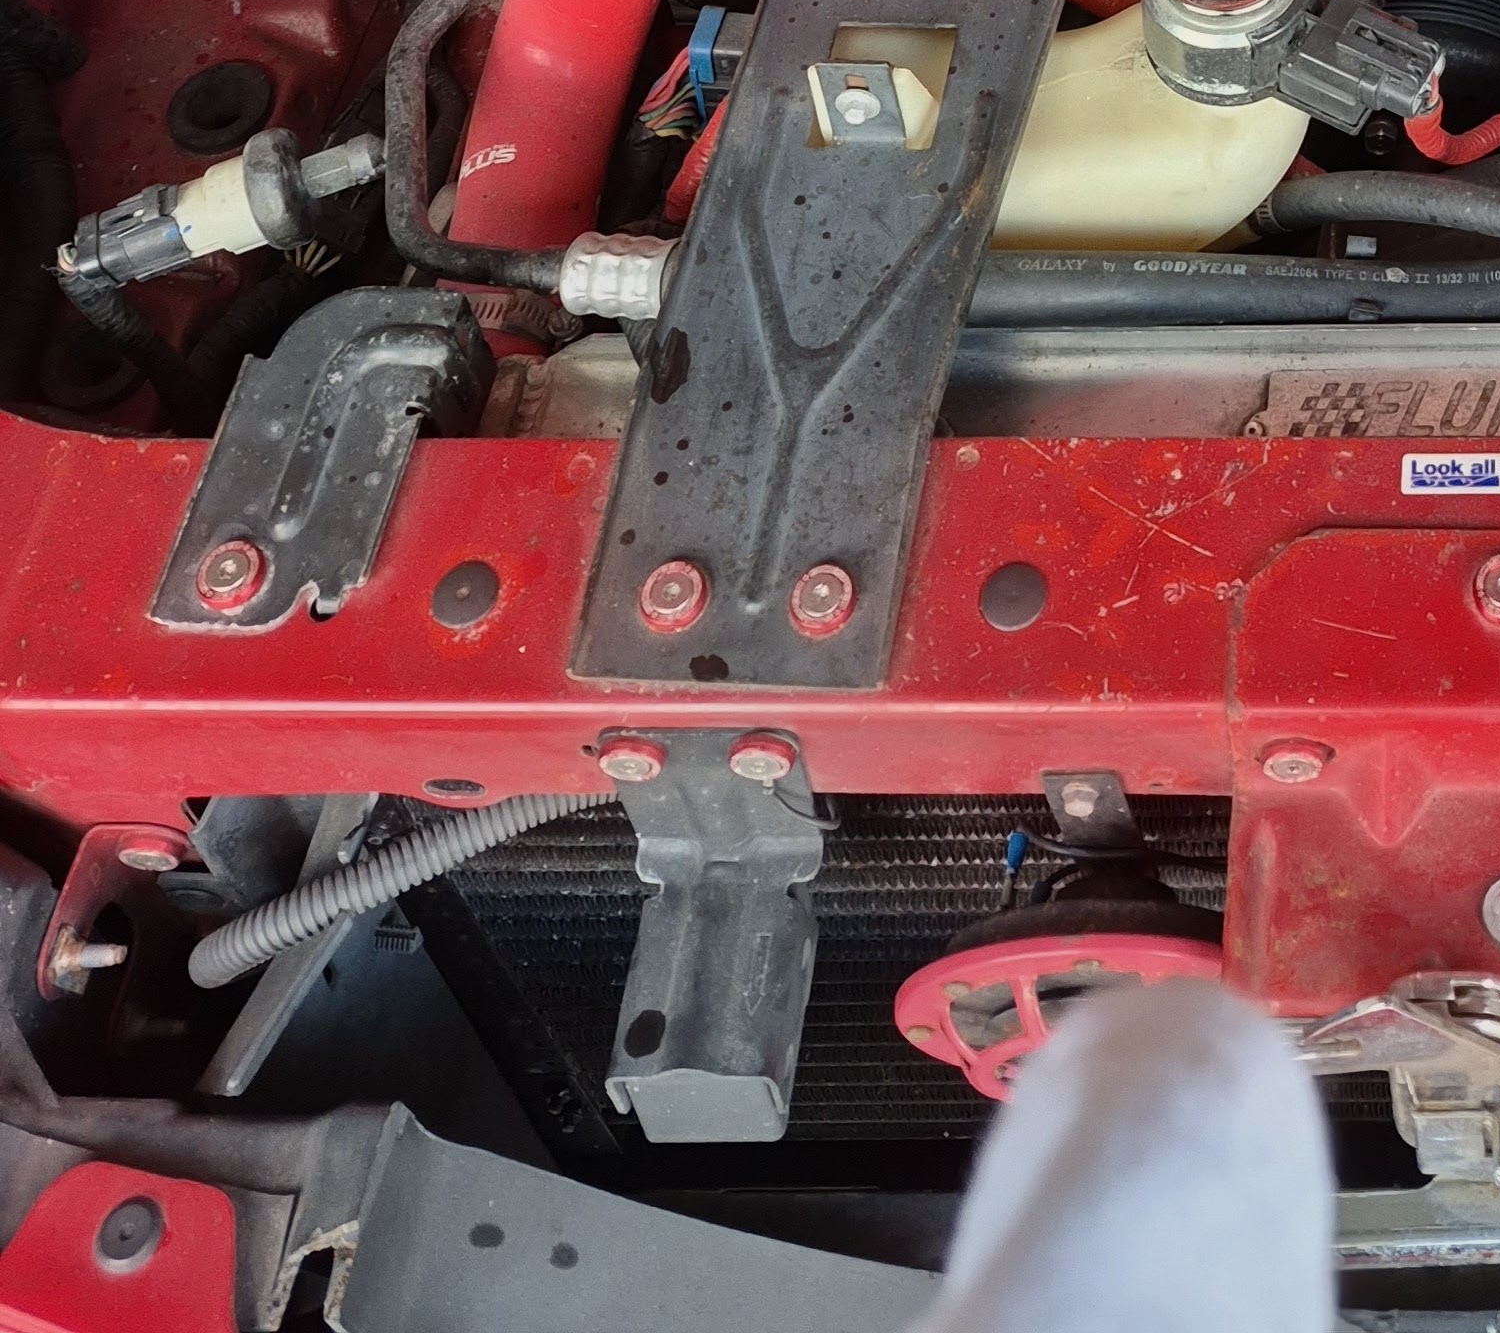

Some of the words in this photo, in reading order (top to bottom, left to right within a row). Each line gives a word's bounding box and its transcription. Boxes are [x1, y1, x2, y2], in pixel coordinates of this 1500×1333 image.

[1017, 258, 1088, 272] GALAXY
[1102, 259, 1117, 273] by
[1133, 259, 1249, 276] GOODYEAR
[1265, 264, 1319, 279] SAEJ2064
[1323, 268, 1354, 281] TYPE
[1359, 269, 1367, 282] C
[1436, 272, 1463, 284] 13/32
[1468, 272, 1480, 283] IN
[1410, 459, 1465, 476] Look
[1470, 458, 1497, 475] all
